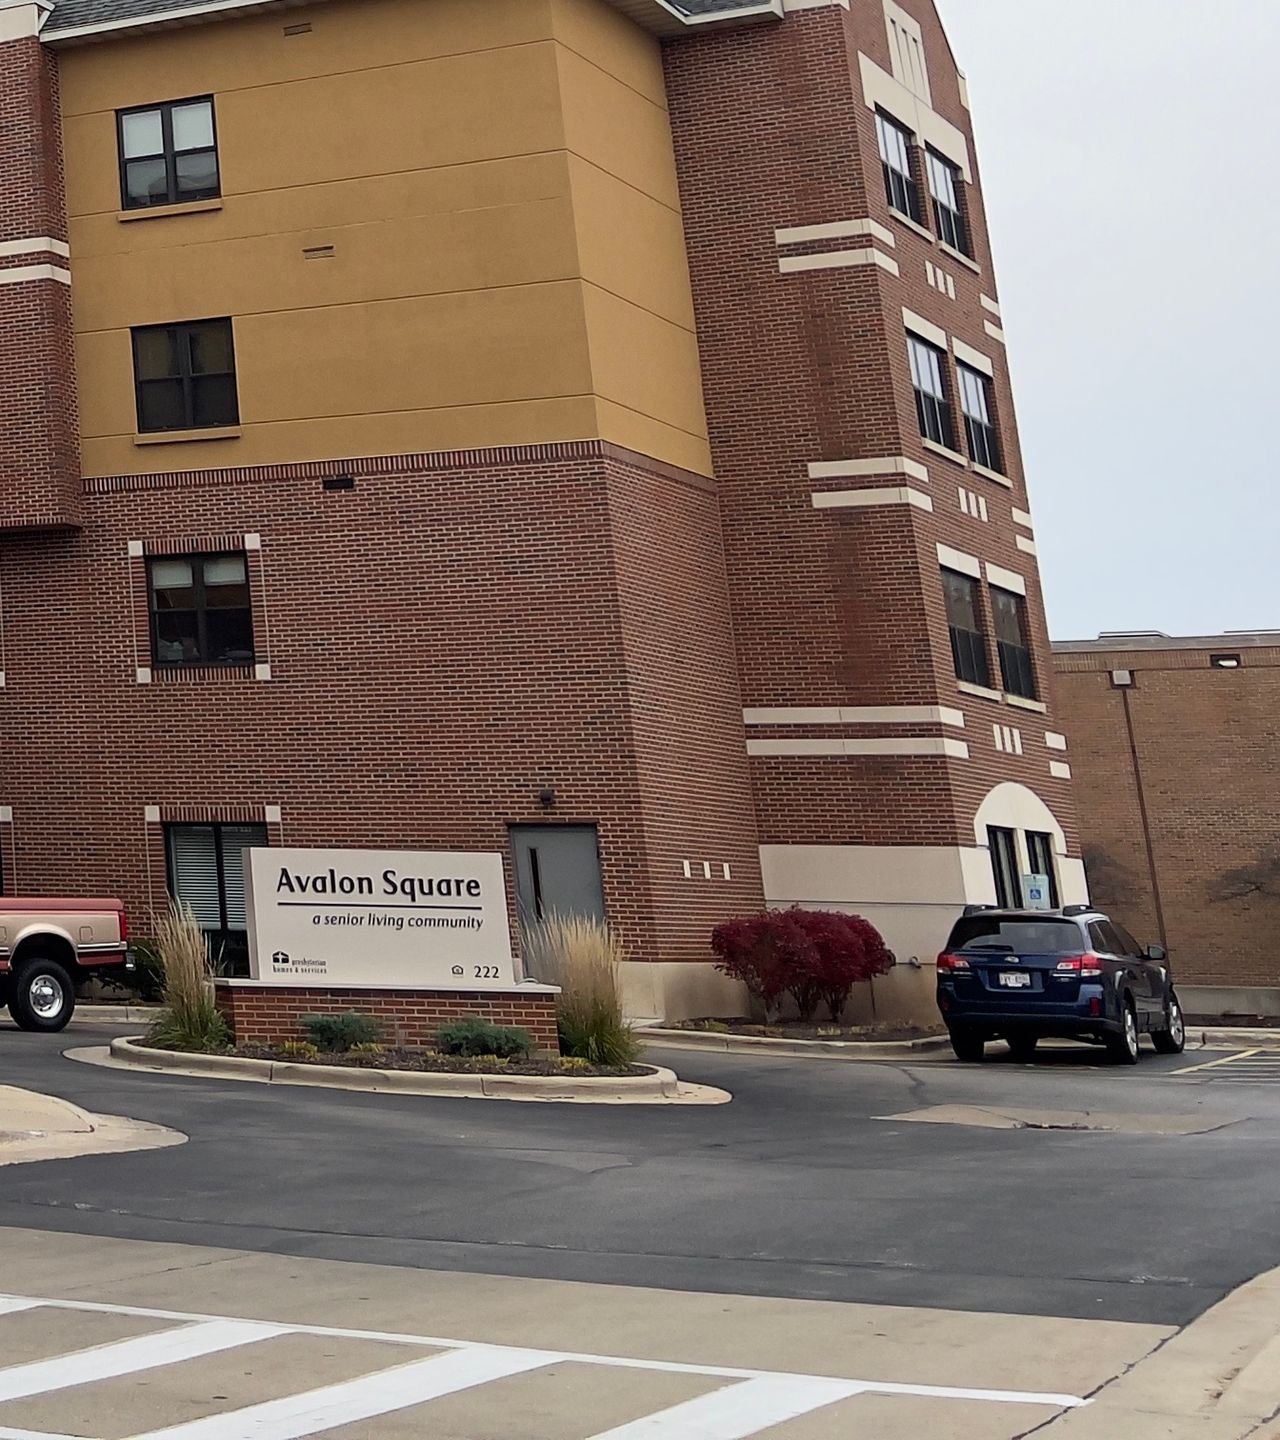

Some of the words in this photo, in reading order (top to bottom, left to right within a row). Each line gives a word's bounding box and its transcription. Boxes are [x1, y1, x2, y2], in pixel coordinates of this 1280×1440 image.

[277, 868, 373, 895] Avalon
[382, 870, 480, 902] Square
[312, 915, 321, 926] a
[324, 913, 364, 927] senior
[368, 913, 404, 930] living
[408, 916, 484, 931] community
[474, 965, 499, 978] 222
